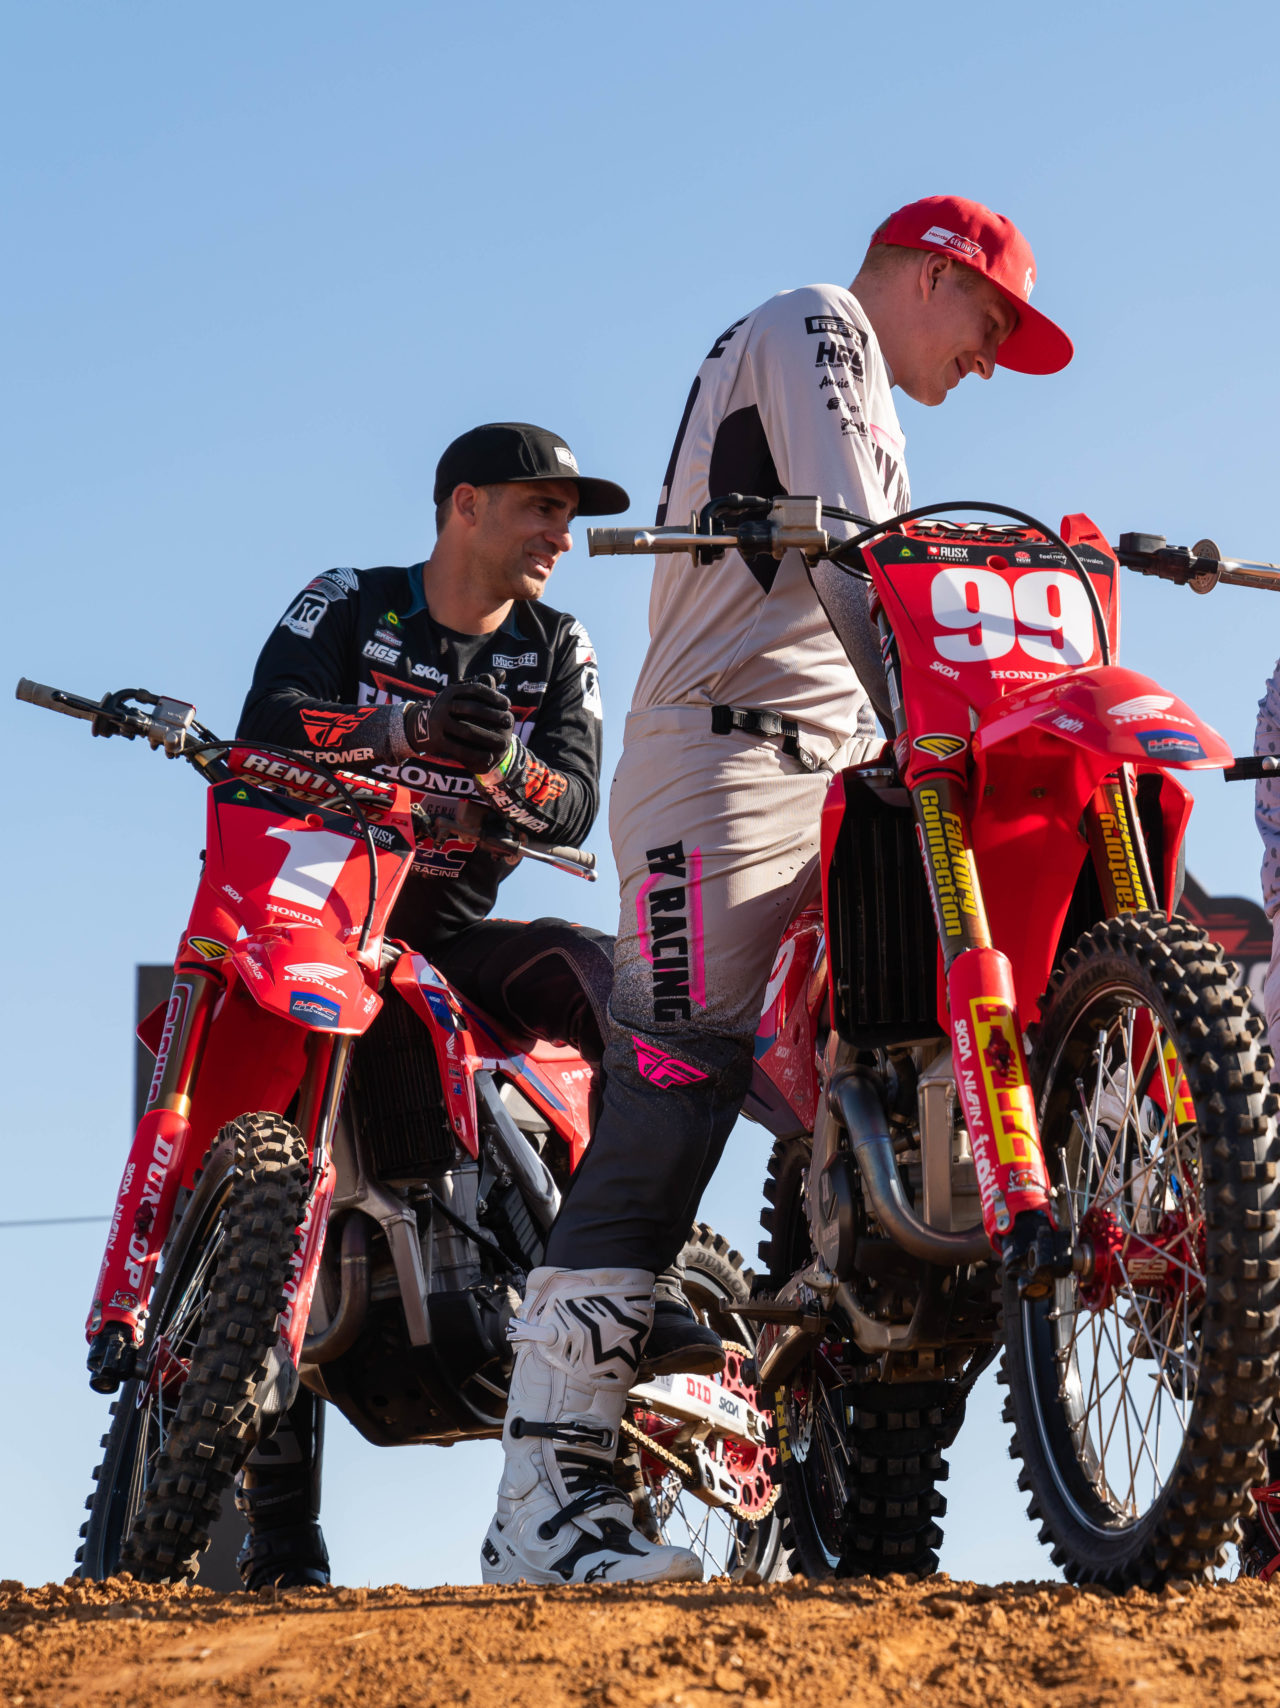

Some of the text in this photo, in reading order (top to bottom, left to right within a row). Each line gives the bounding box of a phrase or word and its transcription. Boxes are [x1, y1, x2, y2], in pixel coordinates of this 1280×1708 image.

[949, 237, 976, 255] GENUINE
[931, 567, 1095, 666] 99
[363, 640, 401, 663] HGS
[495, 653, 536, 668] Muc-Off
[989, 670, 1058, 681] HONDA
[1113, 713, 1196, 728] HONDA
[315, 747, 375, 764] POWER
[265, 826, 357, 911] 1
[942, 810, 979, 918] Factory
[1100, 812, 1137, 914] Factory
[264, 903, 324, 928] HONDA
[648, 887, 692, 1023] RACING
[283, 974, 349, 1000] HONDA
[953, 1018, 973, 1062] SKDA
[977, 1003, 1031, 1160] PIELLI
[120, 1161, 137, 1198] SKDA
[127, 1134, 175, 1290] DUNOP
[686, 1376, 712, 1405] DID
[718, 1396, 741, 1419] SKDA
